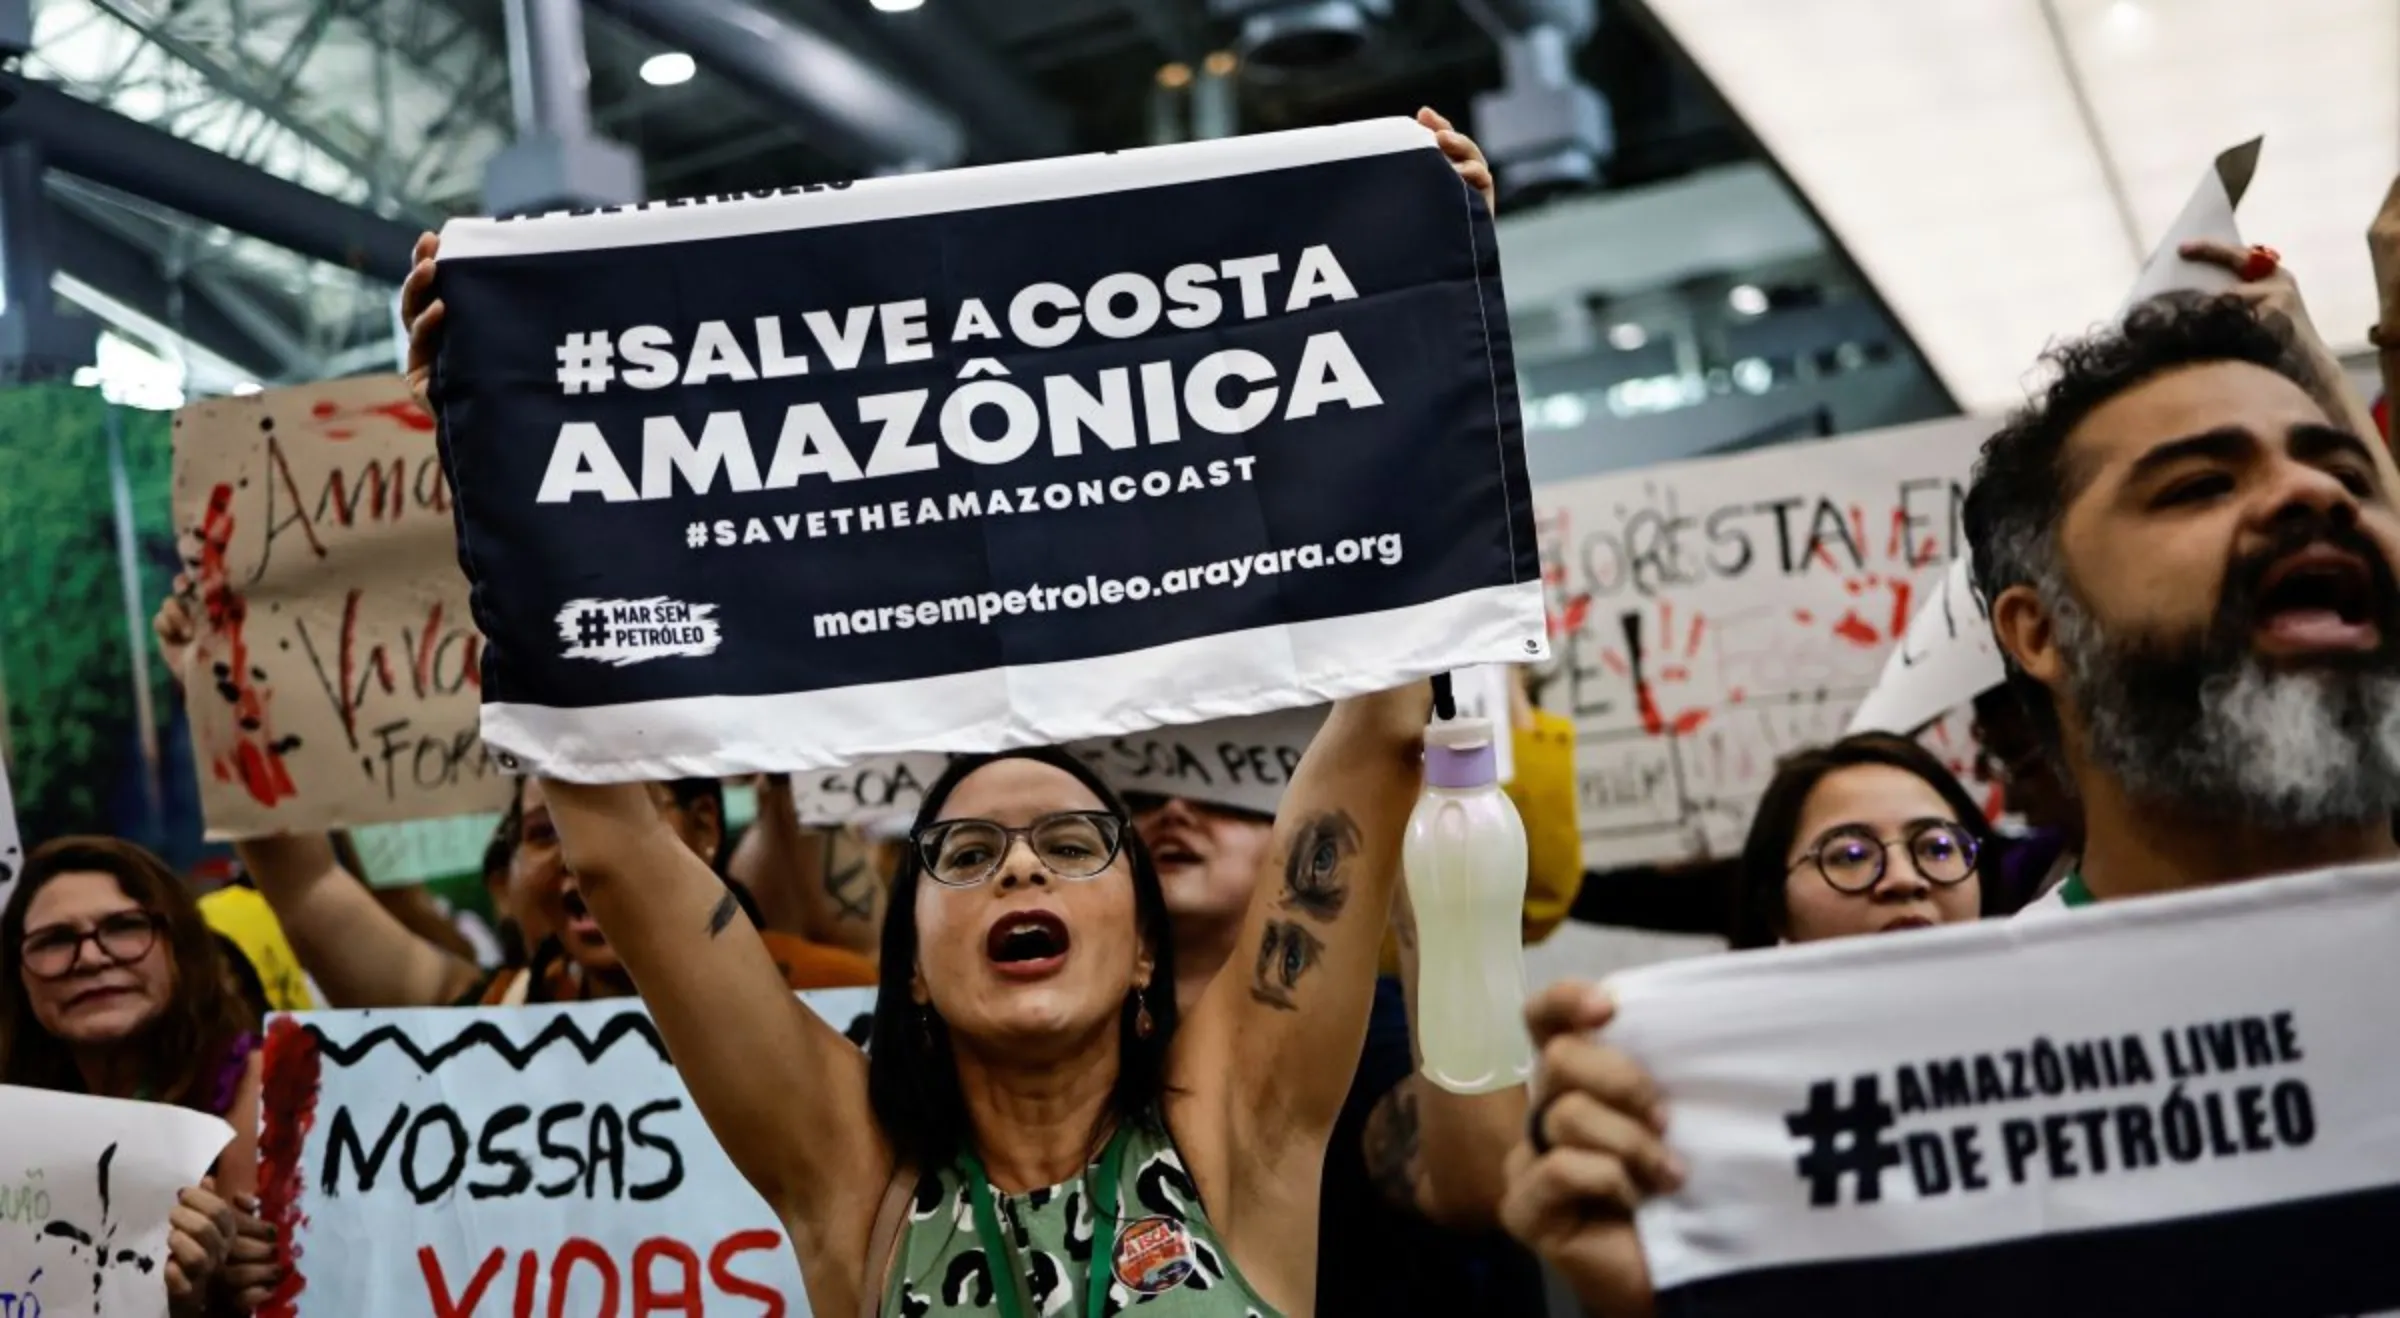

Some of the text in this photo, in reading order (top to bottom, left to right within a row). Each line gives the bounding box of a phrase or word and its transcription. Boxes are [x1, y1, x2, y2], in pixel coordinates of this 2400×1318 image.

[556, 243, 1359, 394] #SALVE A COSTA
[536, 330, 1384, 502] AMAZÔNICA
[686, 455, 1257, 548] #SAVETHEAMAZONCOAST
[613, 605, 652, 625] MAR
[654, 602, 692, 623] SEM
[615, 625, 705, 648] PETRÓLEO
[813, 532, 1403, 638] marsempetroleo.arayara.org
[1896, 1035, 2154, 1115] AMAZÔNIA
[2162, 1009, 2304, 1079] LIVRE
[320, 1097, 685, 1204] NOSSAS
[1906, 1078, 2317, 1198] DE PETRÓLEO
